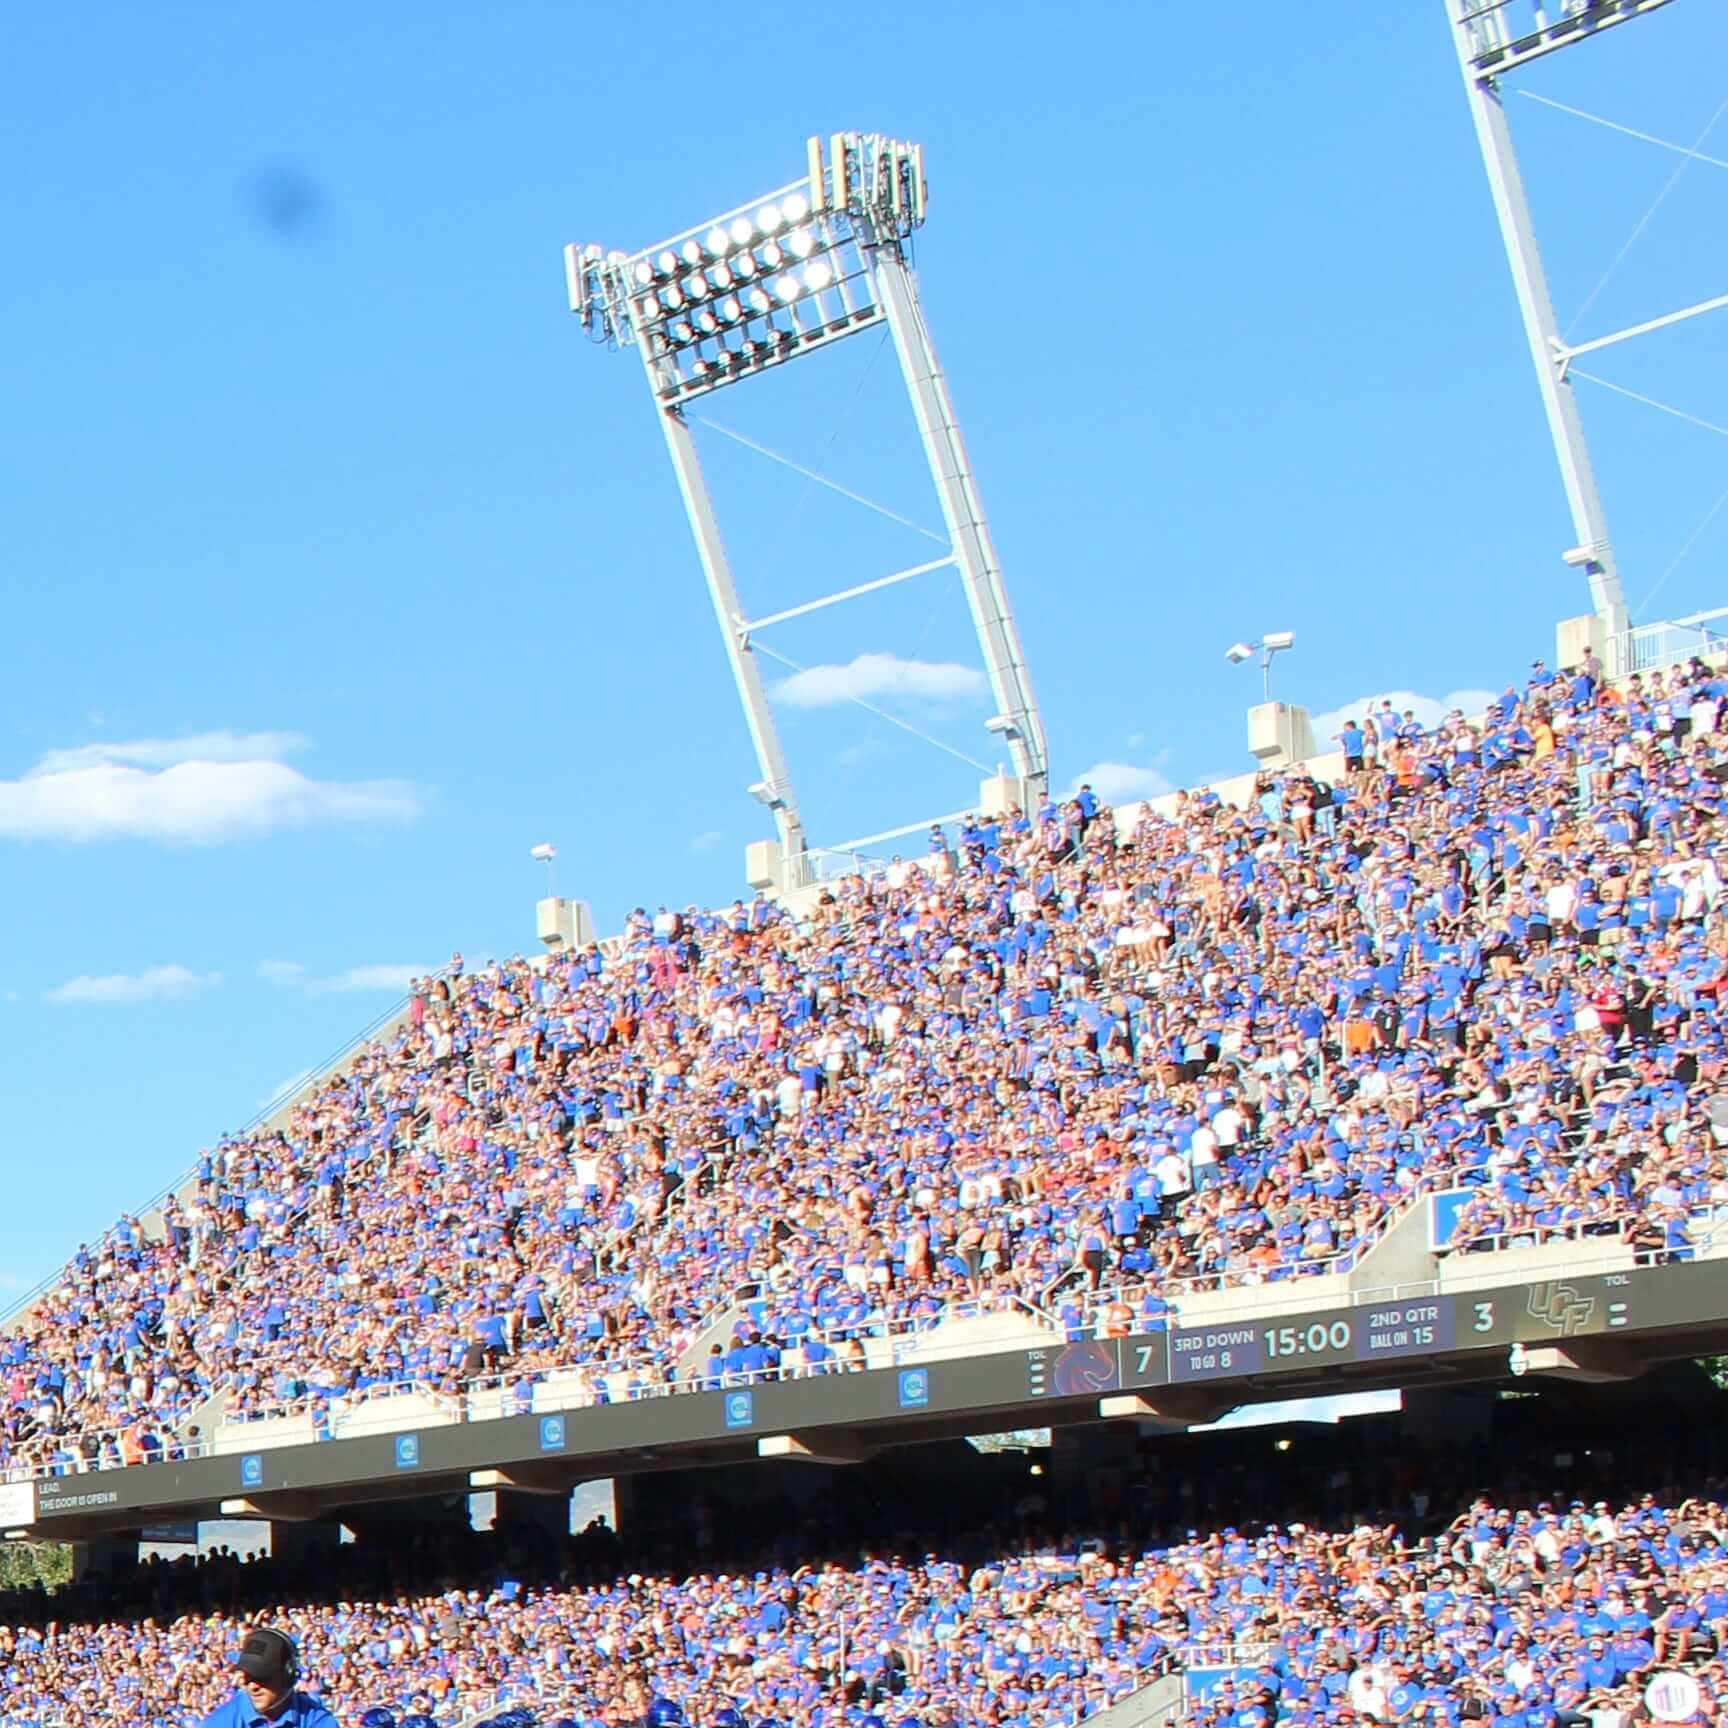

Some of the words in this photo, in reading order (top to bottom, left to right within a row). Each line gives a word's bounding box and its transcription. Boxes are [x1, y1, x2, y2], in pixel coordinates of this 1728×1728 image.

[1604, 1275, 1631, 1287] TOL
[1370, 1311, 1400, 1328] 2ND
[1406, 1306, 1438, 1324] QTR
[1473, 1302, 1494, 1332] 3
[1175, 1336, 1202, 1353] 3RD
[1206, 1330, 1254, 1350] DOWN
[1264, 1321, 1351, 1358] 15:00
[1370, 1333, 1393, 1350] BALL
[1394, 1331, 1408, 1346] ON
[1413, 1326, 1434, 1345] 15
[1027, 1351, 1047, 1361] TOL
[1136, 1345, 1152, 1374] 7
[1190, 1357, 1202, 1371] TO
[1203, 1355, 1215, 1369] GO
[1220, 1351, 1232, 1368] 8
